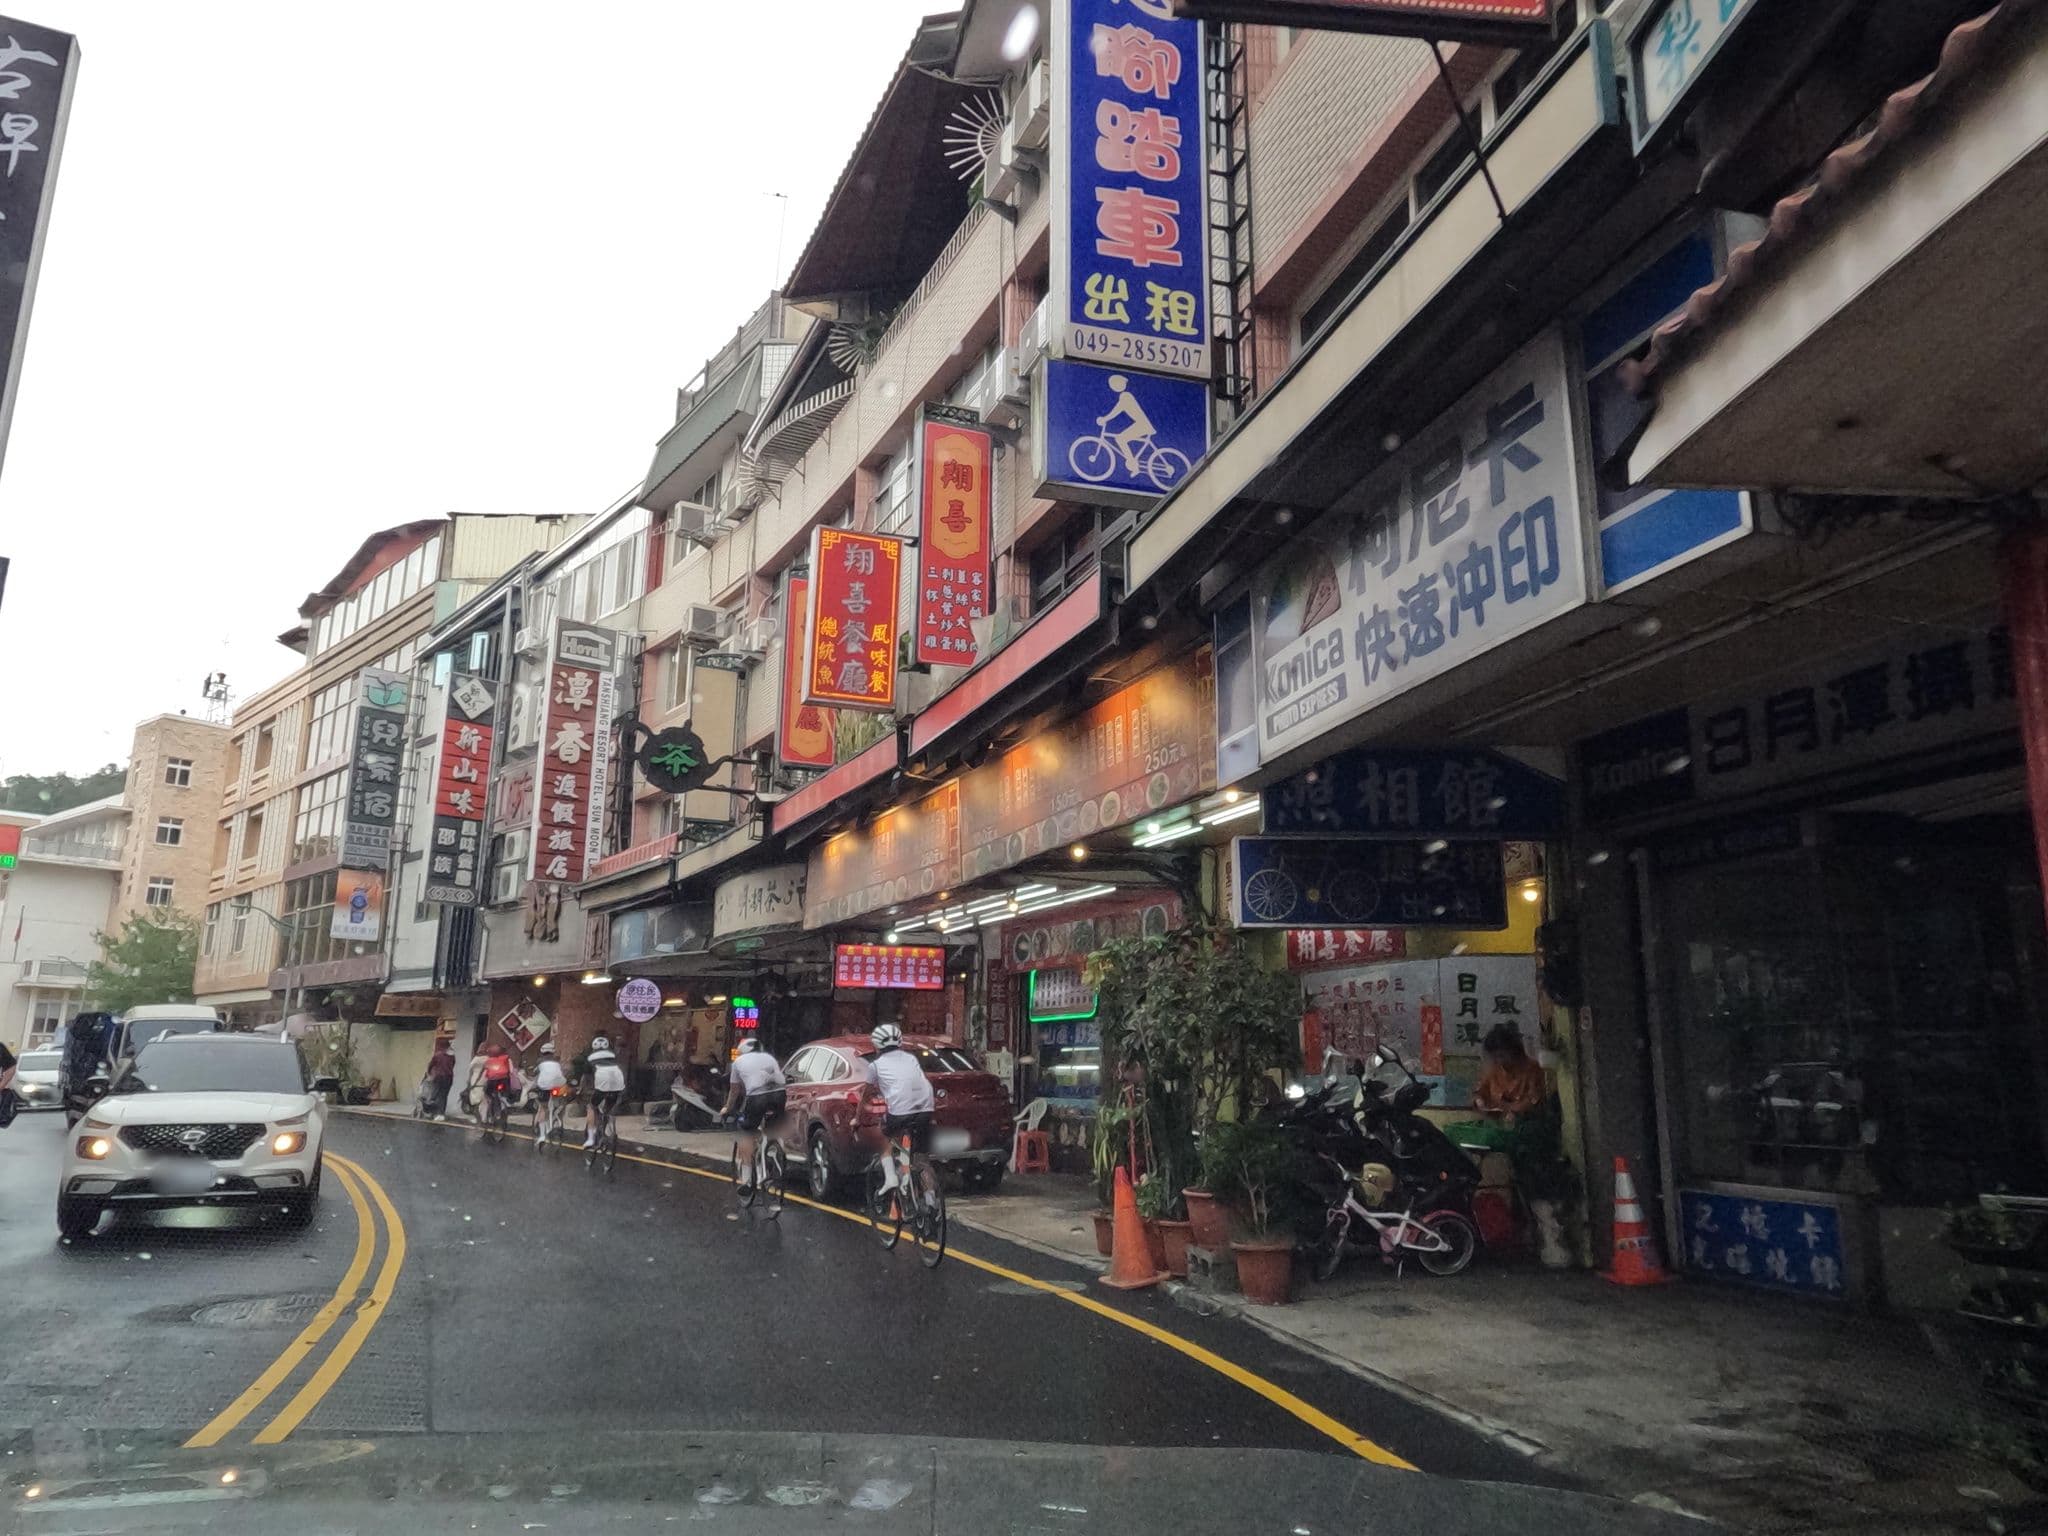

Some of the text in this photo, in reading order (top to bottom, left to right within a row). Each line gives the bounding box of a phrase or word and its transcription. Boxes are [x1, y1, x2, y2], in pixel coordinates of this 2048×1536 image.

[1084, 272, 1199, 335] 出租
[1074, 329, 1202, 369] 049-2855207
[940, 459, 972, 533] 翔喜
[1348, 381, 1545, 597] 柯尼卡
[835, 543, 875, 695] 翔喜餐廳
[954, 569, 968, 653] 薑絲大腸
[560, 634, 611, 661] HOTEL
[817, 616, 839, 686] 總統魚
[868, 624, 891, 694] 風味餐
[1264, 627, 1346, 705] Konica
[449, 725, 483, 815] 新山味
[593, 767, 605, 796] HOTEL
[595, 729, 608, 765] RESORT
[649, 742, 699, 778] 茶
[588, 828, 601, 854] MOON
[591, 804, 602, 824] SUN
[1455, 973, 1483, 1047] 日月潭
